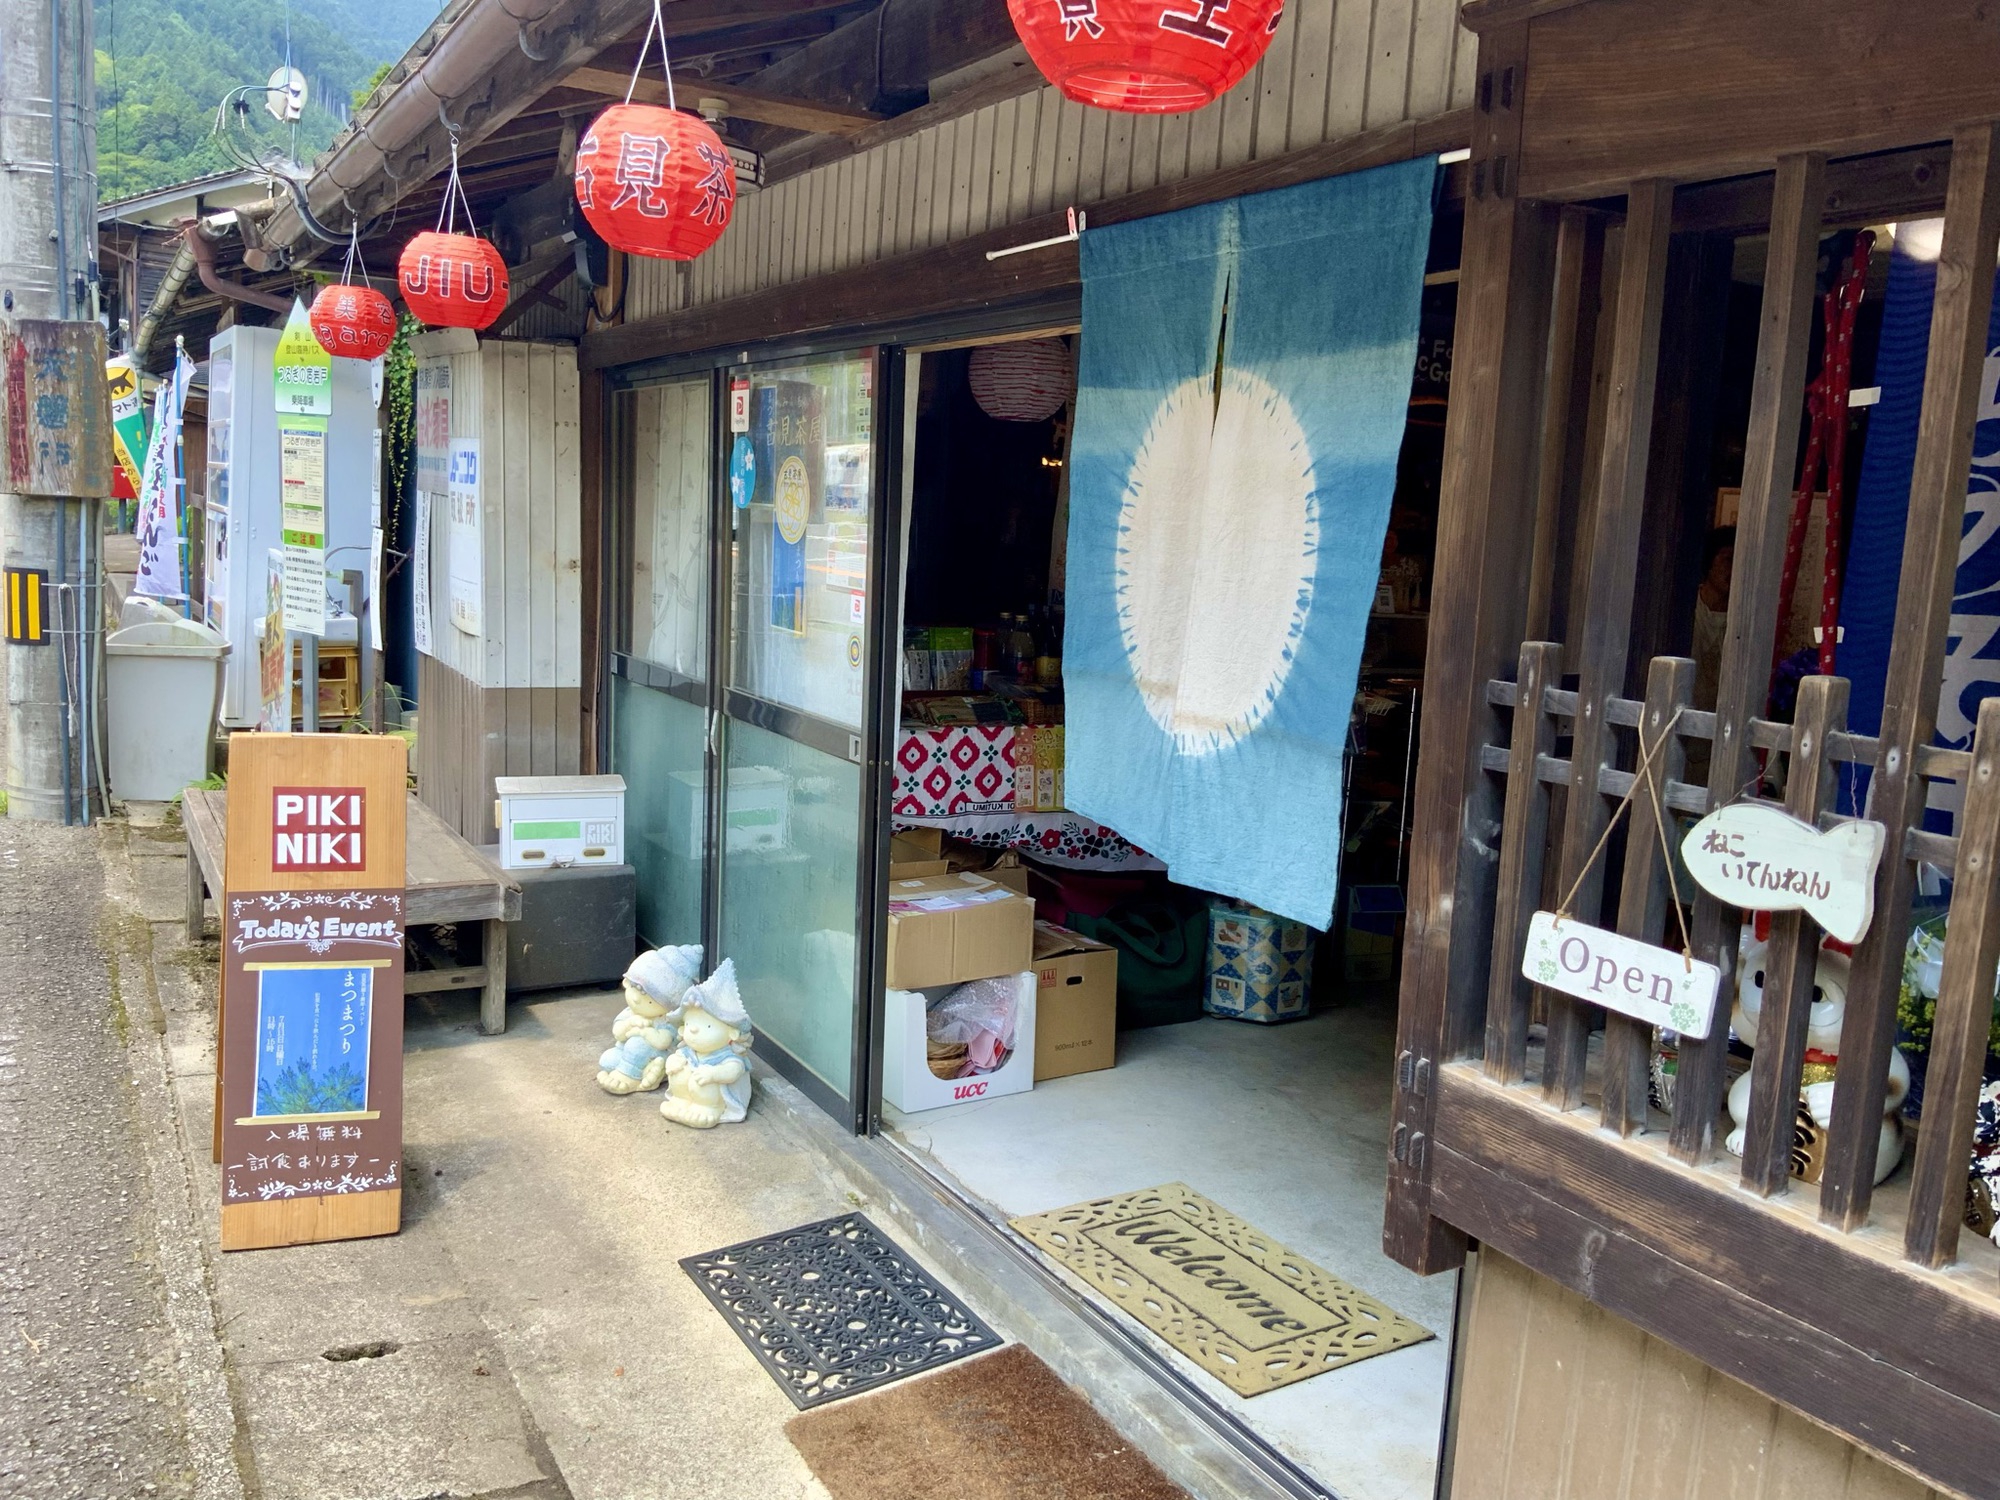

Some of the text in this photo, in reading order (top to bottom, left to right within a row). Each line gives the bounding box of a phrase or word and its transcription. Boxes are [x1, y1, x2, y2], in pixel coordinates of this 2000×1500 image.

[312, 324, 390, 350] garo
[278, 366, 328, 385] つるぎの宿岩戸
[291, 531, 316, 546] ご注意
[277, 794, 361, 826] PIKI
[587, 823, 615, 834] PIKI
[587, 833, 615, 844] NIKI
[276, 832, 361, 865] NIKI
[1701, 829, 1746, 858] ねこ
[1721, 860, 1831, 901] いてんねん
[239, 915, 397, 940] Today's Event
[1559, 936, 1674, 1006] Open
[340, 970, 357, 1055] まつまつり
[266, 1123, 363, 1142] 入場無料
[1115, 1220, 1308, 1334] Welcome
